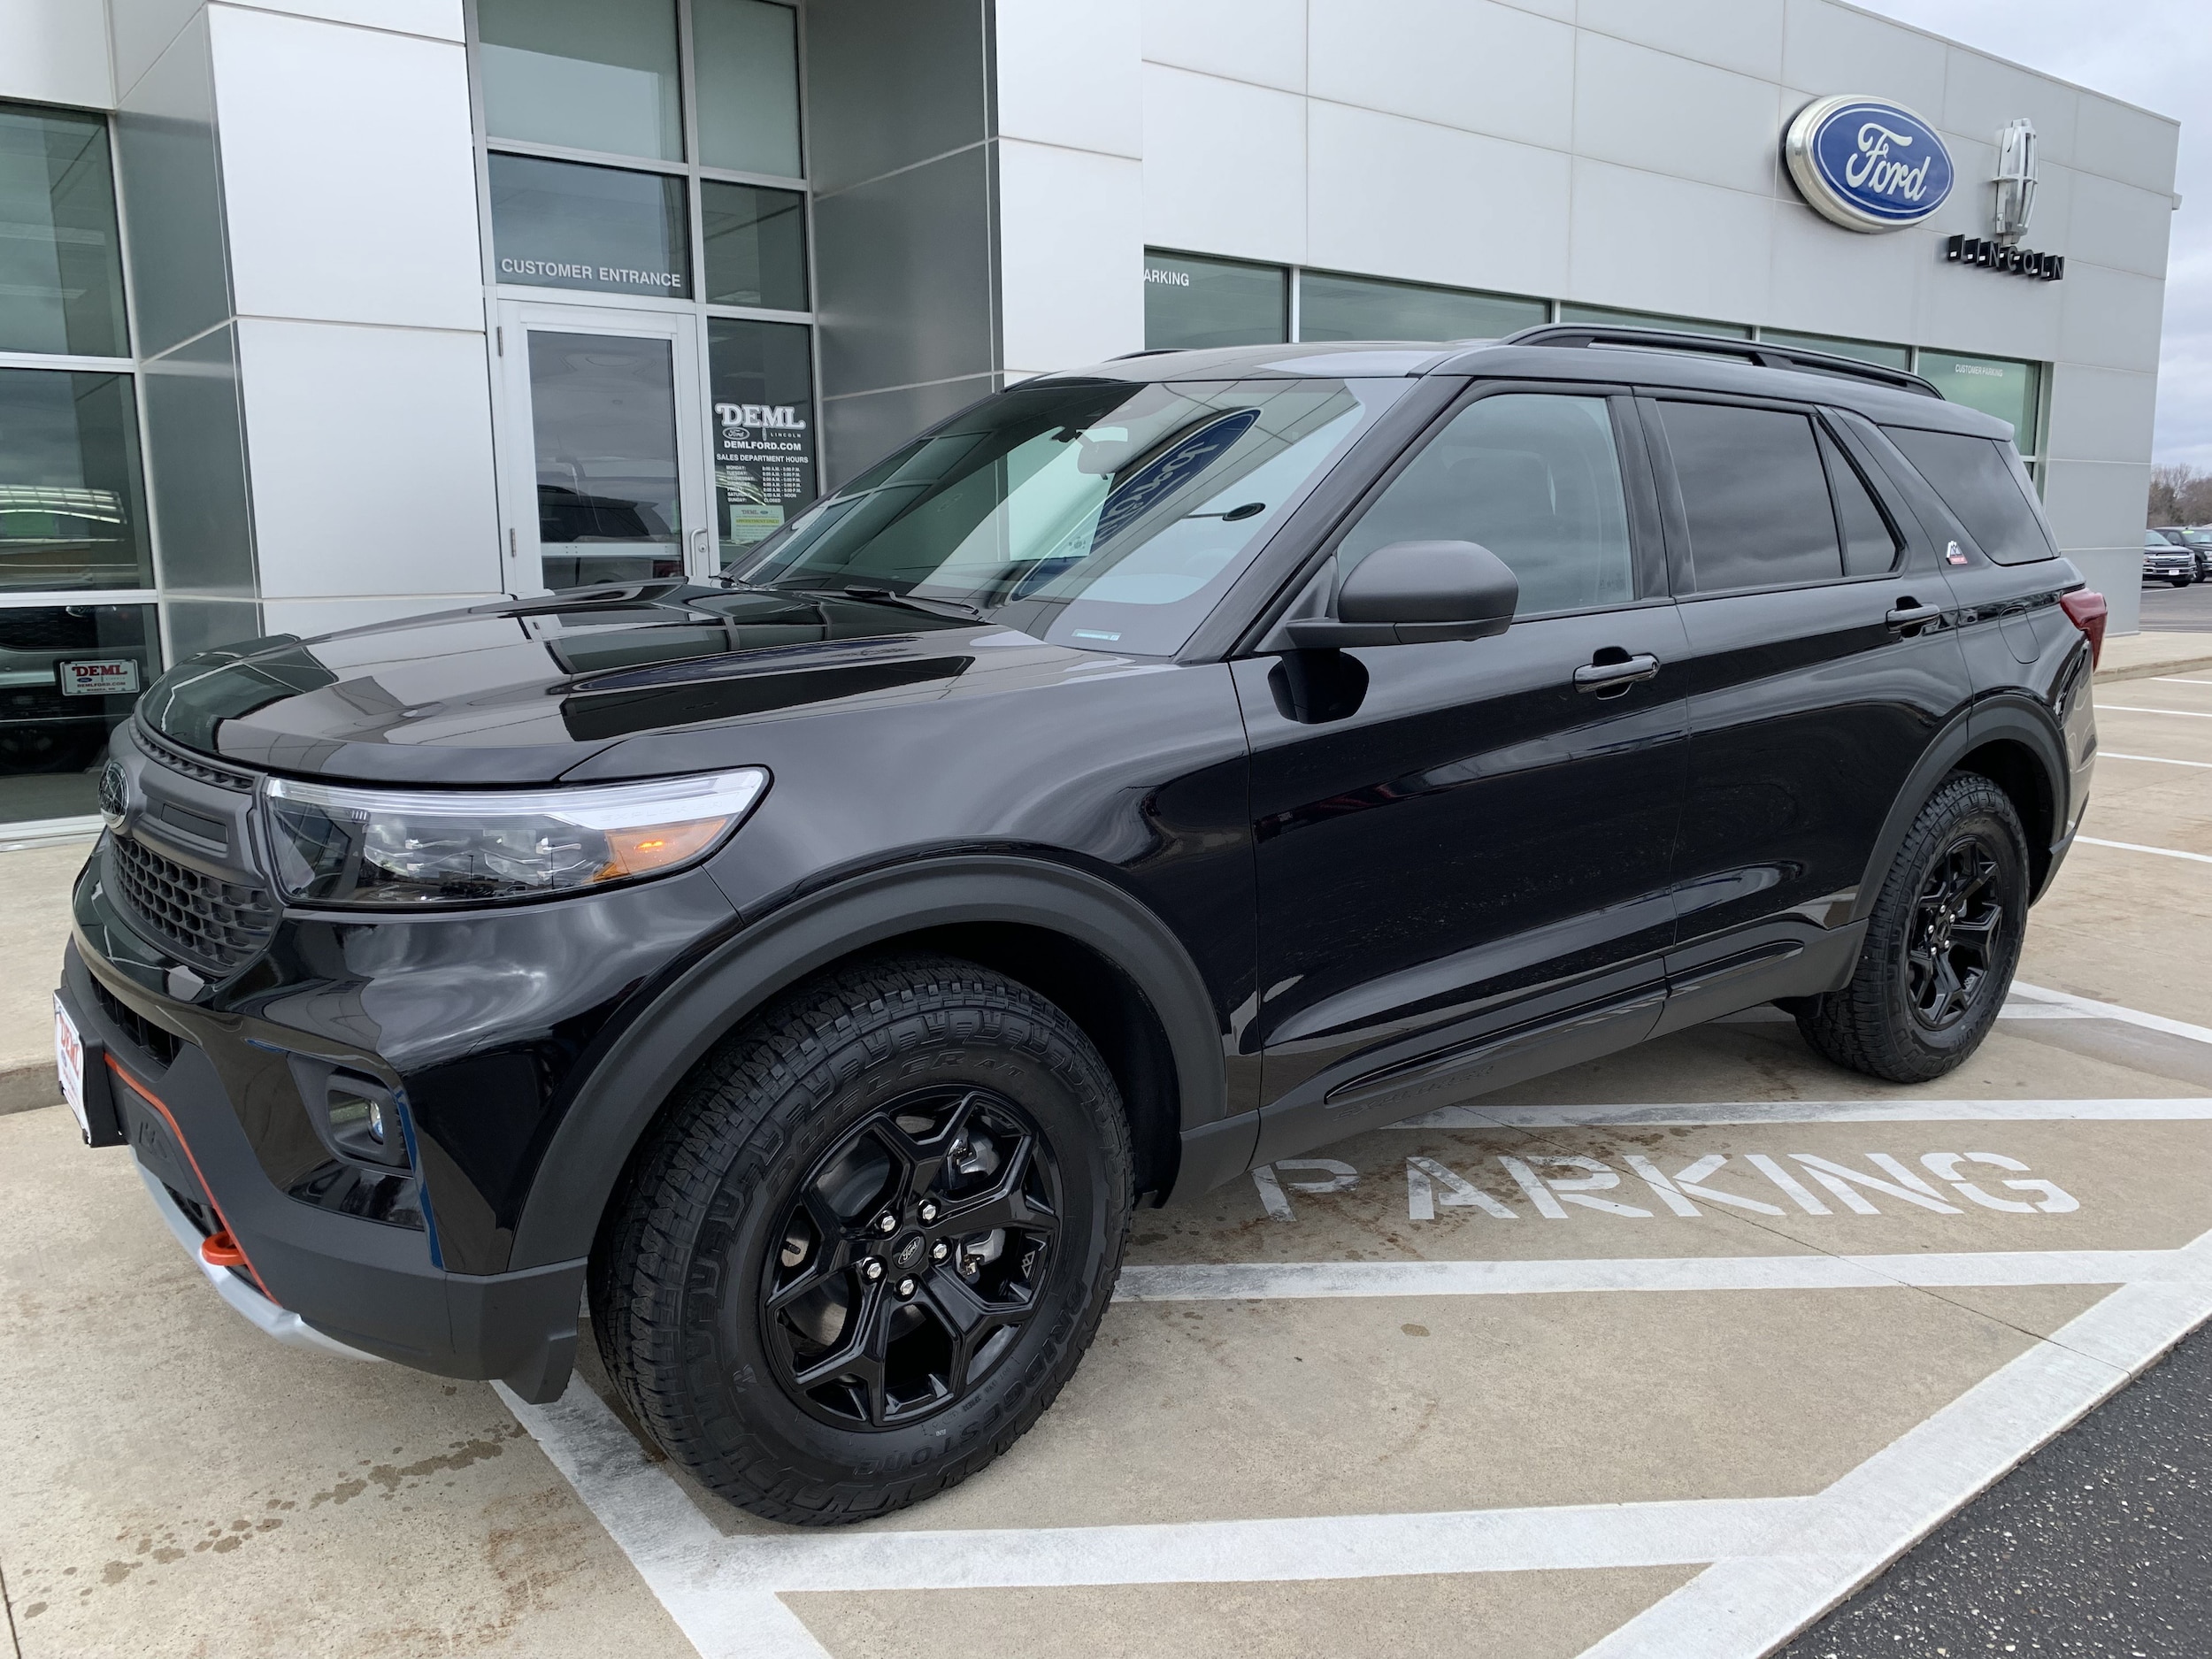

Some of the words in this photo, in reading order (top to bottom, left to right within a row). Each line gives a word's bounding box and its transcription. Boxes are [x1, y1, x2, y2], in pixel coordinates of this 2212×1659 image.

[1846, 122, 1932, 202] Ford
[1948, 234, 2065, 280] LINCOLN
[502, 258, 592, 280] CUSTOMER
[599, 267, 681, 288] ENTRANCE
[1144, 269, 1189, 287] ARKING
[1955, 364, 1982, 373] CUSTOMER
[1982, 367, 2003, 377] PARKING
[715, 403, 806, 429] DEML
[724, 441, 802, 451] DEMLFORD.COM
[726, 428, 746, 438] Ford
[740, 454, 784, 463] DEPARTMENT
[72, 664, 127, 677] DEML
[765, 1050, 966, 1197] DUELER
[972, 1058, 1026, 1079] A/T
[1250, 1151, 2081, 1221] PARKING
[853, 1280, 1088, 1476] BRIDGESTONE
